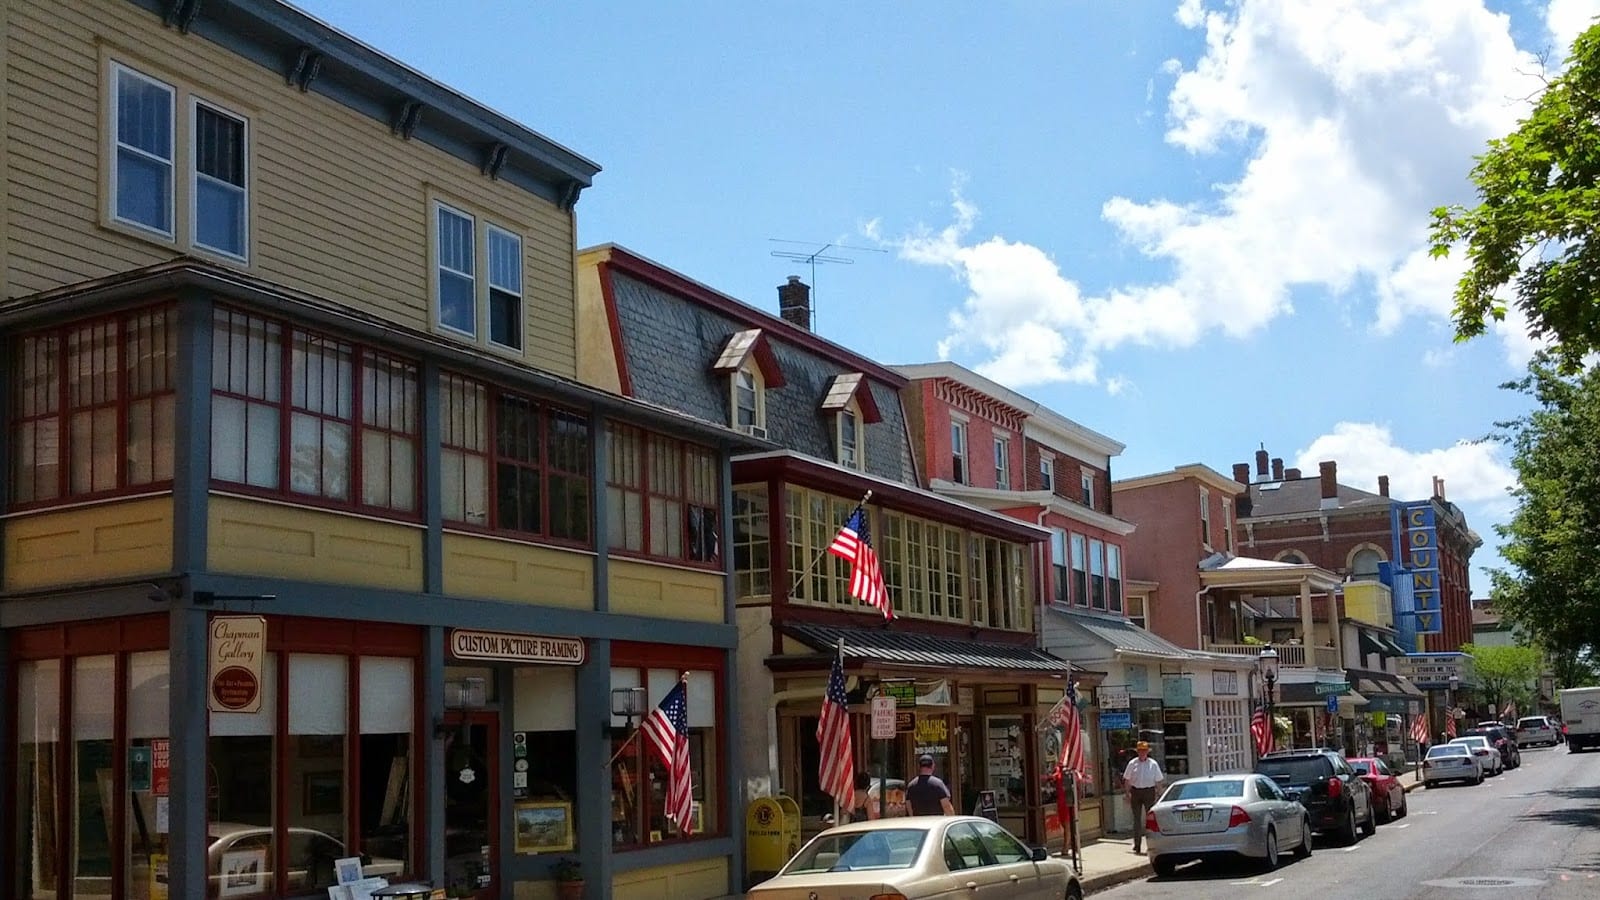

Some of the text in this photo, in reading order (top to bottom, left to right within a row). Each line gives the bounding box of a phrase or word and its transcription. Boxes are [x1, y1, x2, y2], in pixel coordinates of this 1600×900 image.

[1411, 510, 1432, 630] COUNTY
[215, 622, 260, 642] Chapman
[218, 641, 254, 662] Gallery
[459, 635, 579, 658] CUSTOM PICTURE FRAMING
